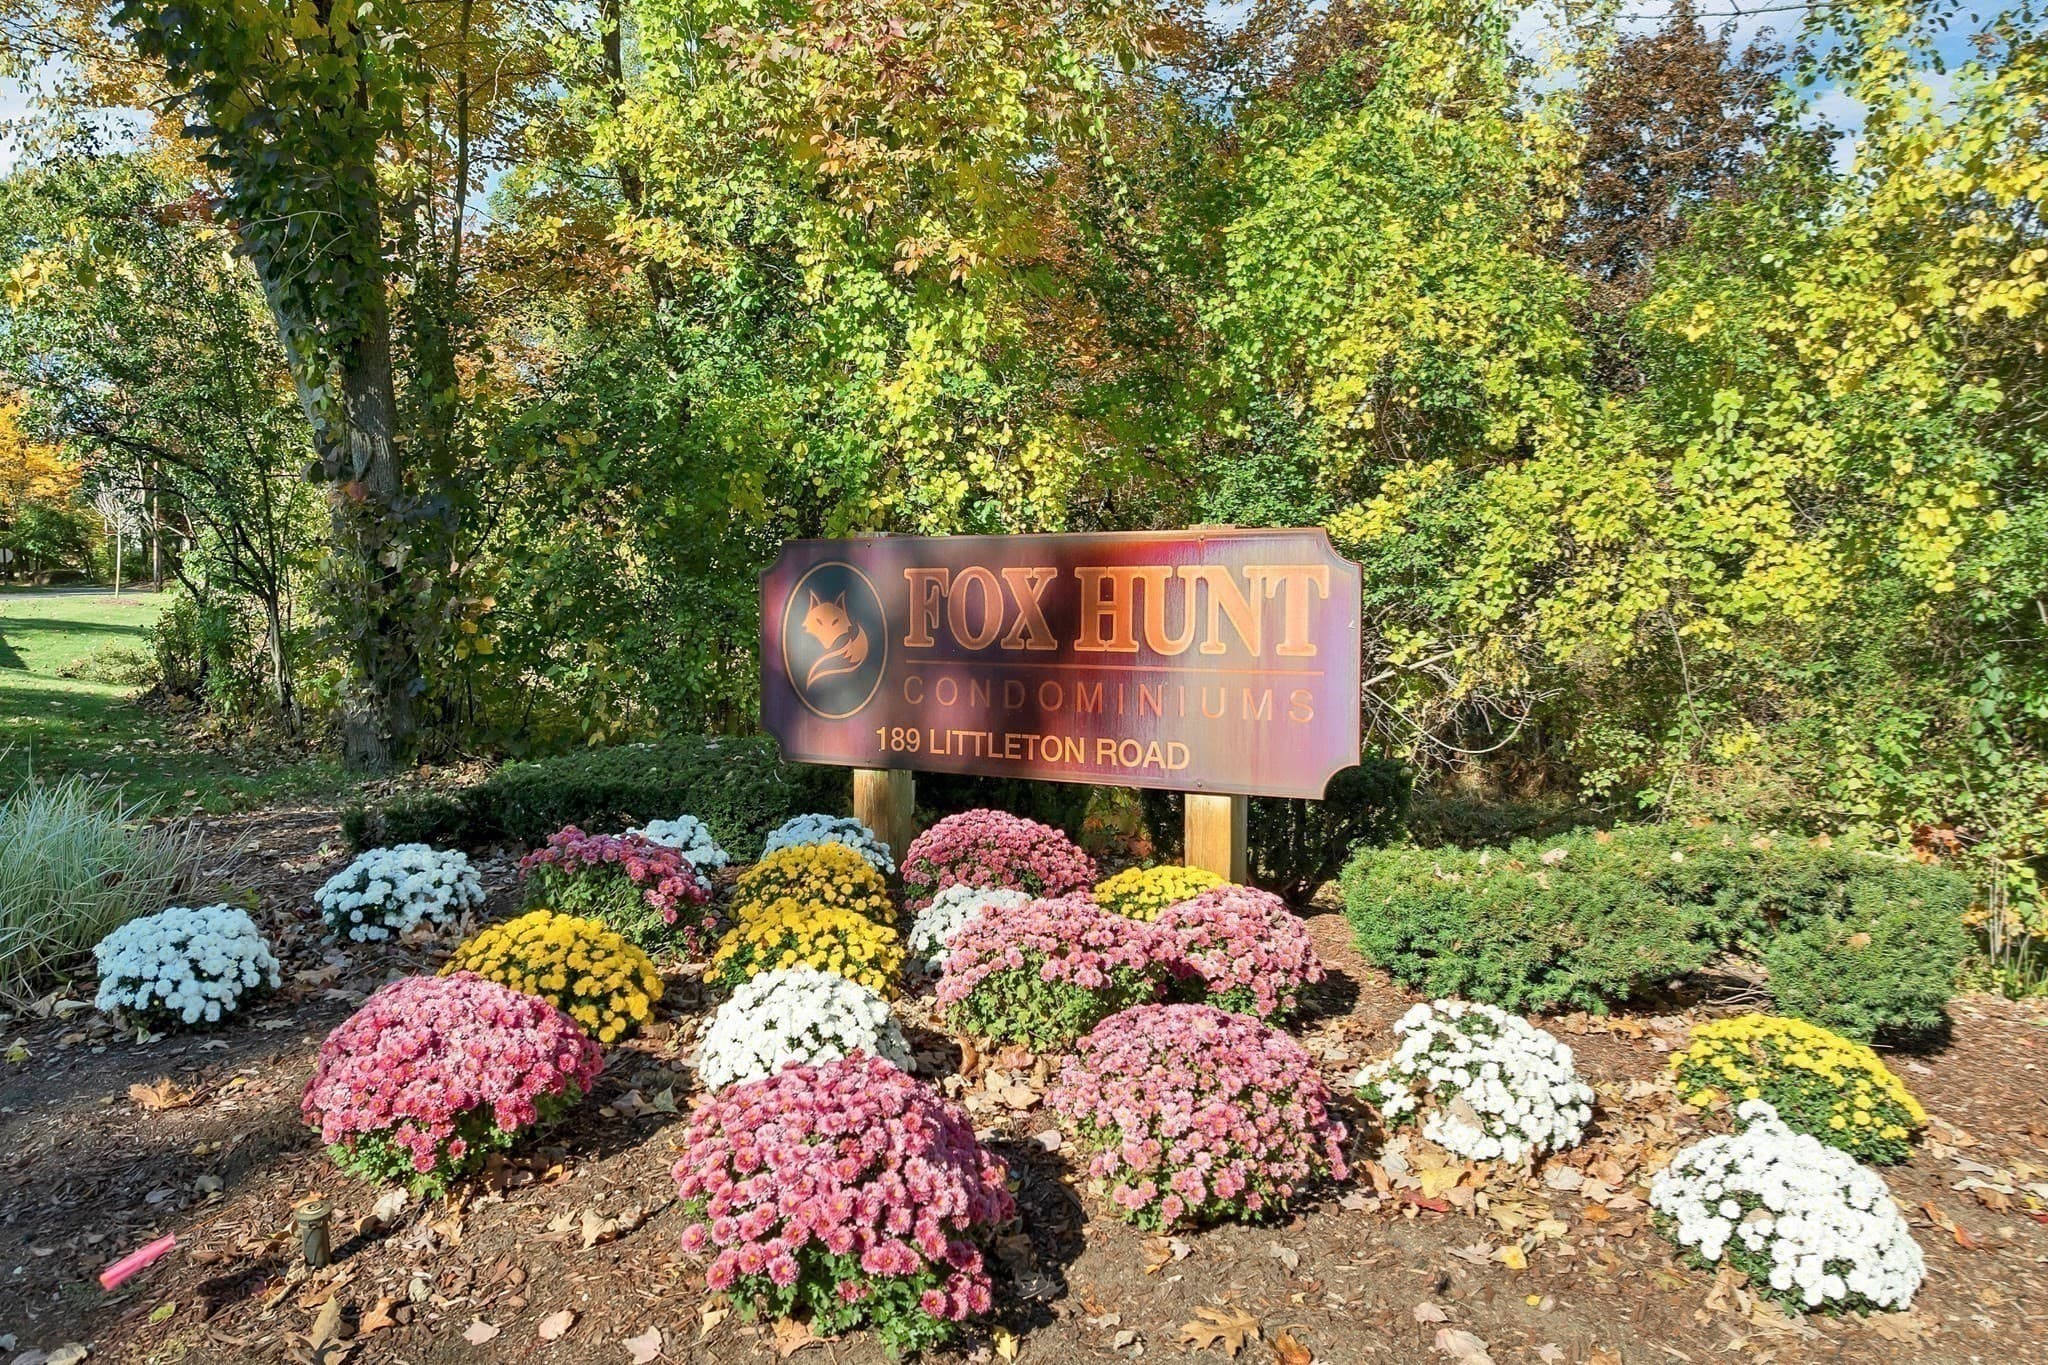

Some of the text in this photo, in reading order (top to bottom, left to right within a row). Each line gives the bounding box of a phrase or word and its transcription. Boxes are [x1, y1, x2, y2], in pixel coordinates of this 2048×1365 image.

[903, 564, 1330, 657] FOX HUNT
[904, 676, 1315, 722] CONDOMINIUMS
[875, 726, 1191, 771] 189 LITTLETON ROAD
